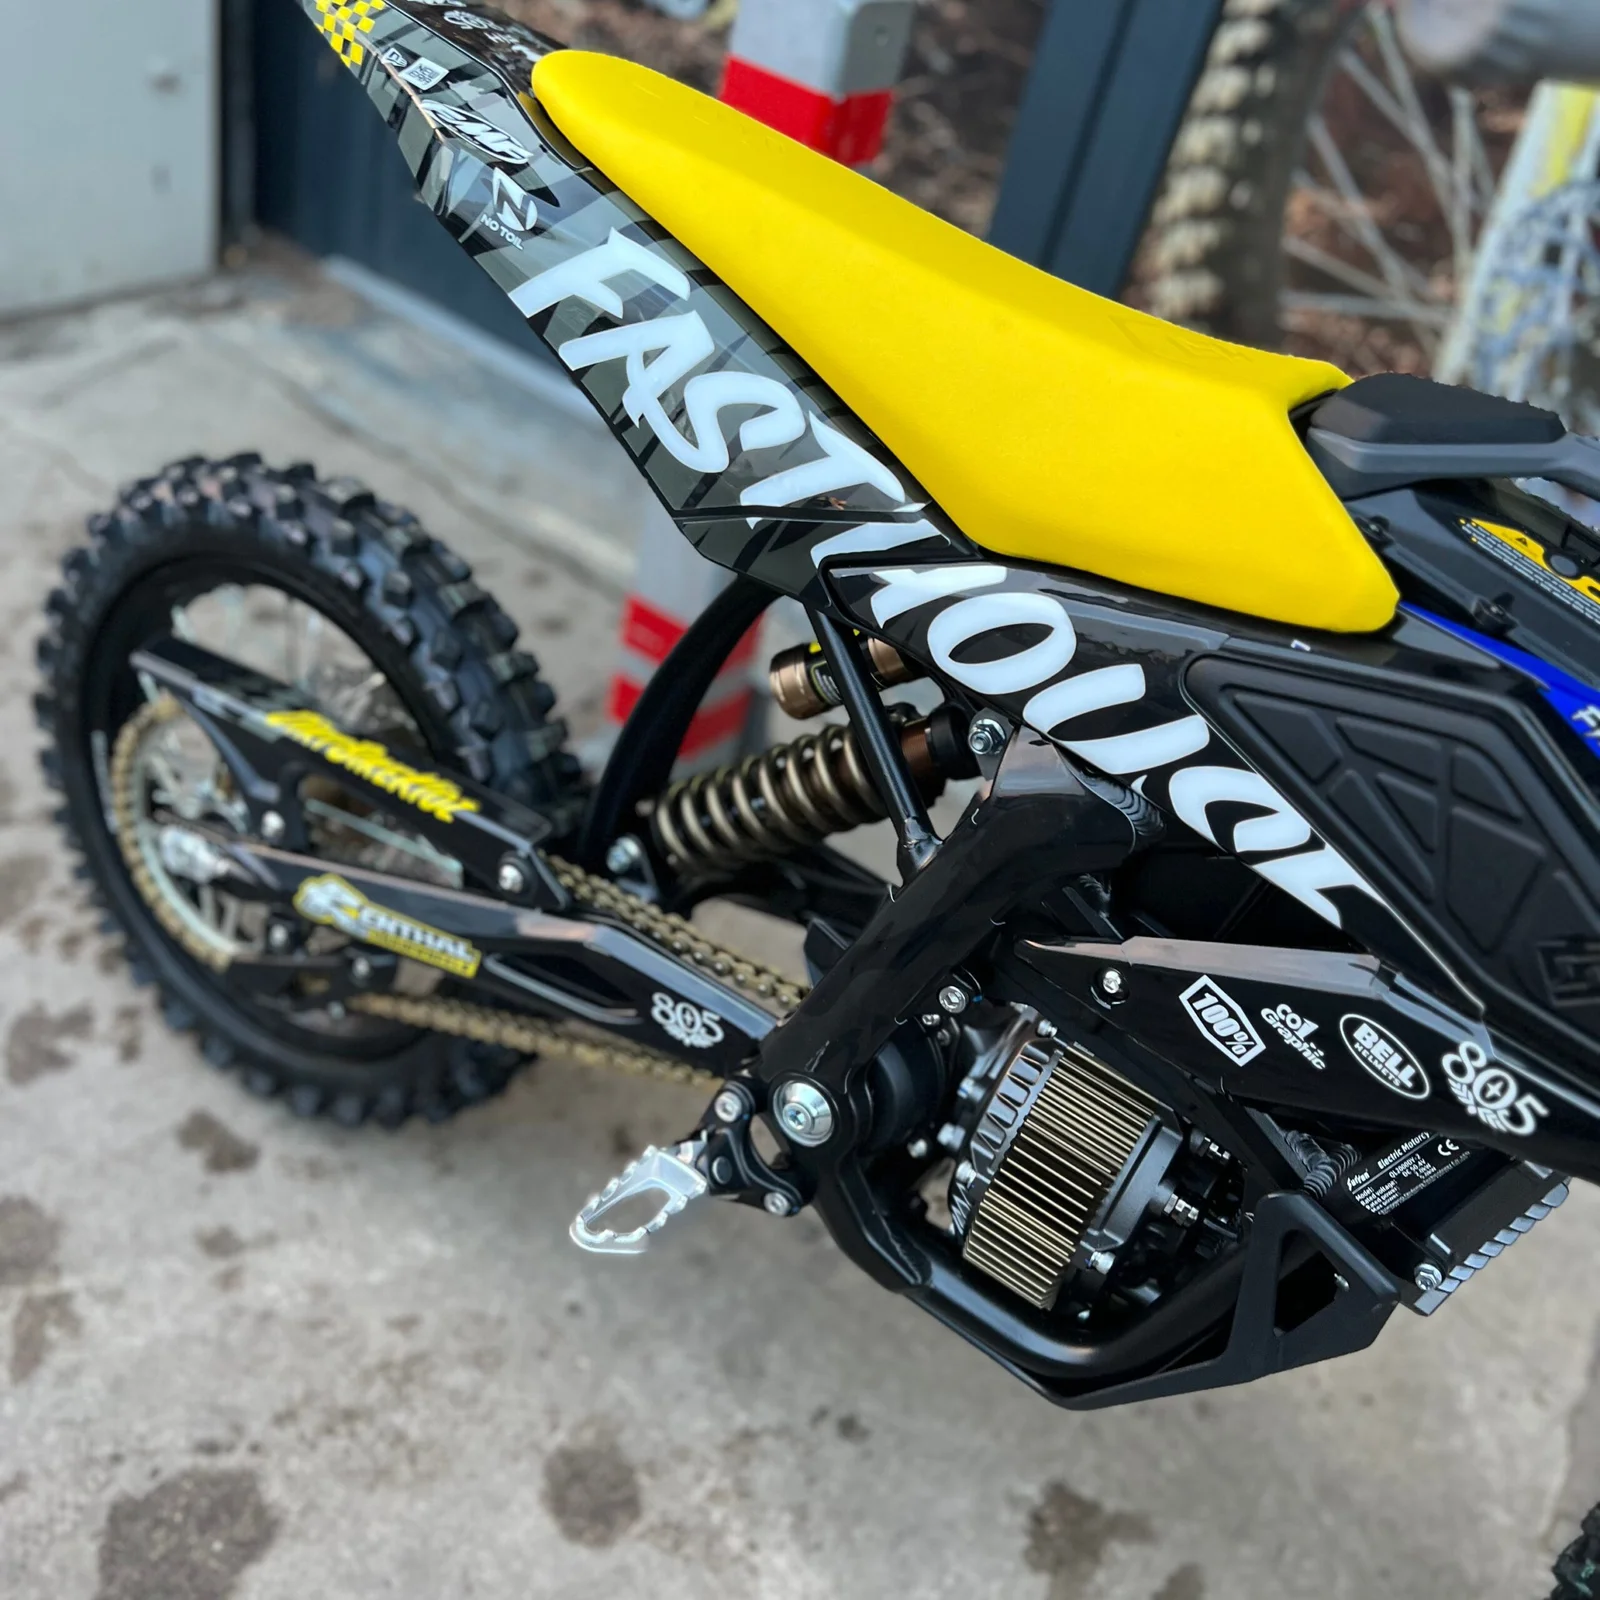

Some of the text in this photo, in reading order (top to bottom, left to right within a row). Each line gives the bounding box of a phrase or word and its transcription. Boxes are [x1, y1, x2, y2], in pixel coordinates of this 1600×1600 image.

[480, 214, 525, 251] NO TOIL
[650, 991, 725, 1044] 805
[1192, 992, 1255, 1056] 100%
[1260, 1007, 1327, 1071] Graphic
[1352, 1022, 1420, 1090] BELL
[1353, 1042, 1402, 1087] HELMETS
[1441, 1040, 1549, 1136] 805
[1377, 1148, 1404, 1170] Electric
